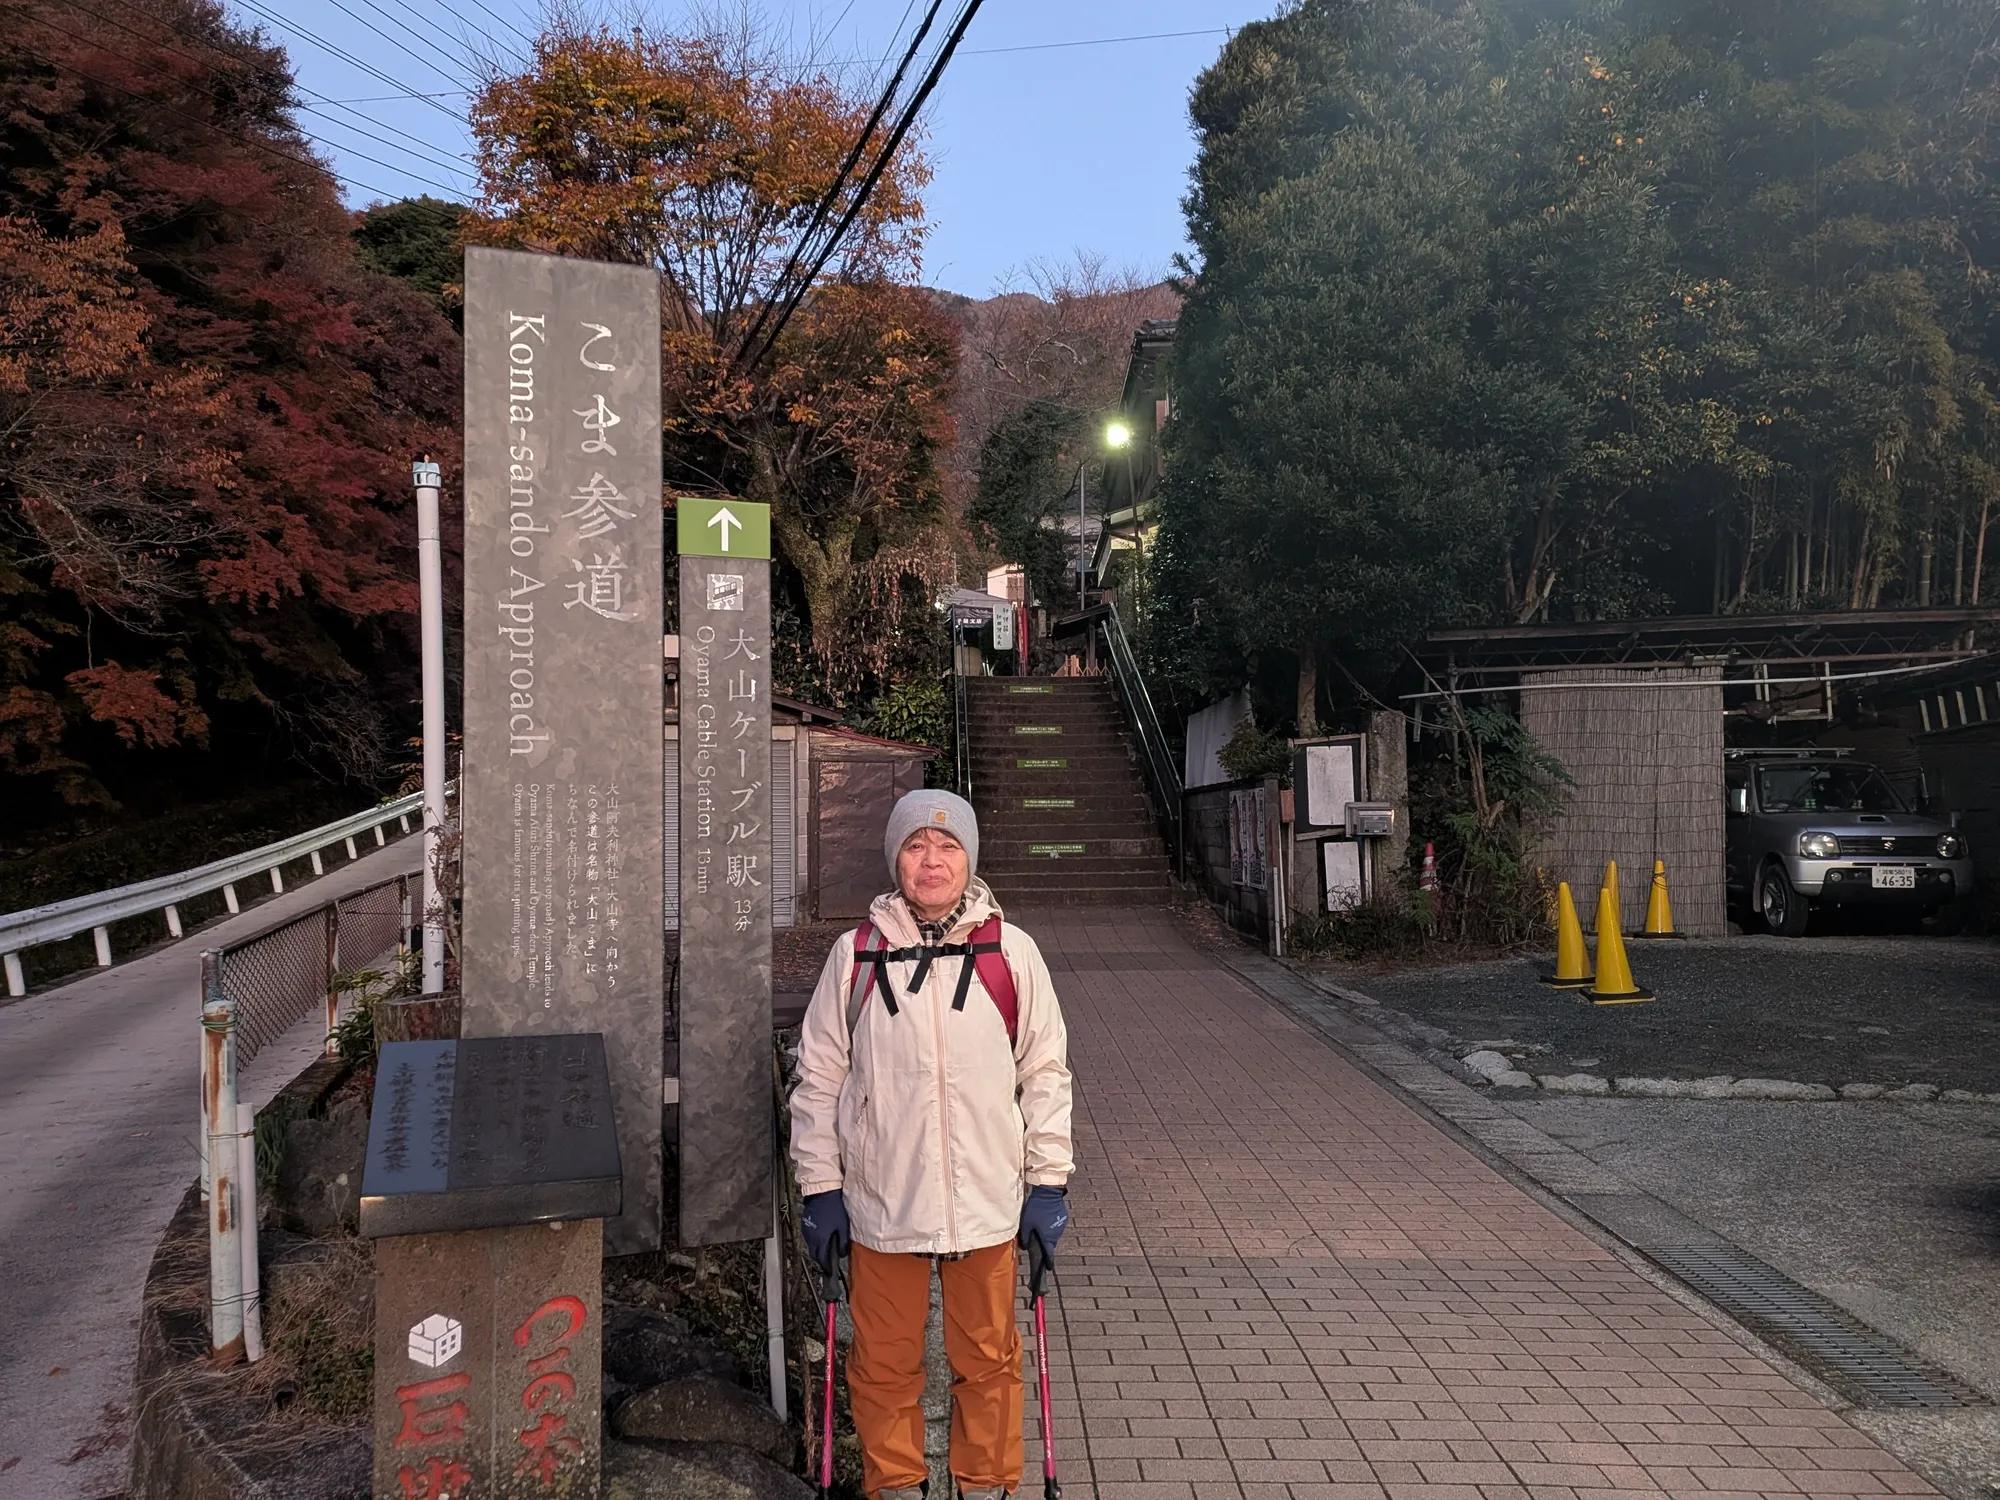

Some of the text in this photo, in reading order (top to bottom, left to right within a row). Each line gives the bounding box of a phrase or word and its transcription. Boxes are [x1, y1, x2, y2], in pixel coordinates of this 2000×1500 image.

[562, 321, 638, 623] こま参道
[498, 311, 550, 757] Koma-sando Approach
[692, 625, 718, 894] Oyama Cable Station 13min
[723, 628, 763, 932] 大山ケーブル駅 13分
[512, 783, 524, 817] Oyama
[528, 783, 540, 817] Oyama
[514, 819, 524, 827] is
[514, 829, 525, 862] famous
[530, 845, 540, 876] Shrine
[514, 865, 525, 879] for
[530, 877, 540, 894] and
[565, 783, 580, 960] ちなんで名付けられました。
[584, 784, 601, 974] この参道は名物「大山こま」に
[1881, 875, 1913, 887] 46-35
[511, 893, 522, 934] spinning
[511, 936, 521, 957] tops.
[543, 928, 555, 971] Approach
